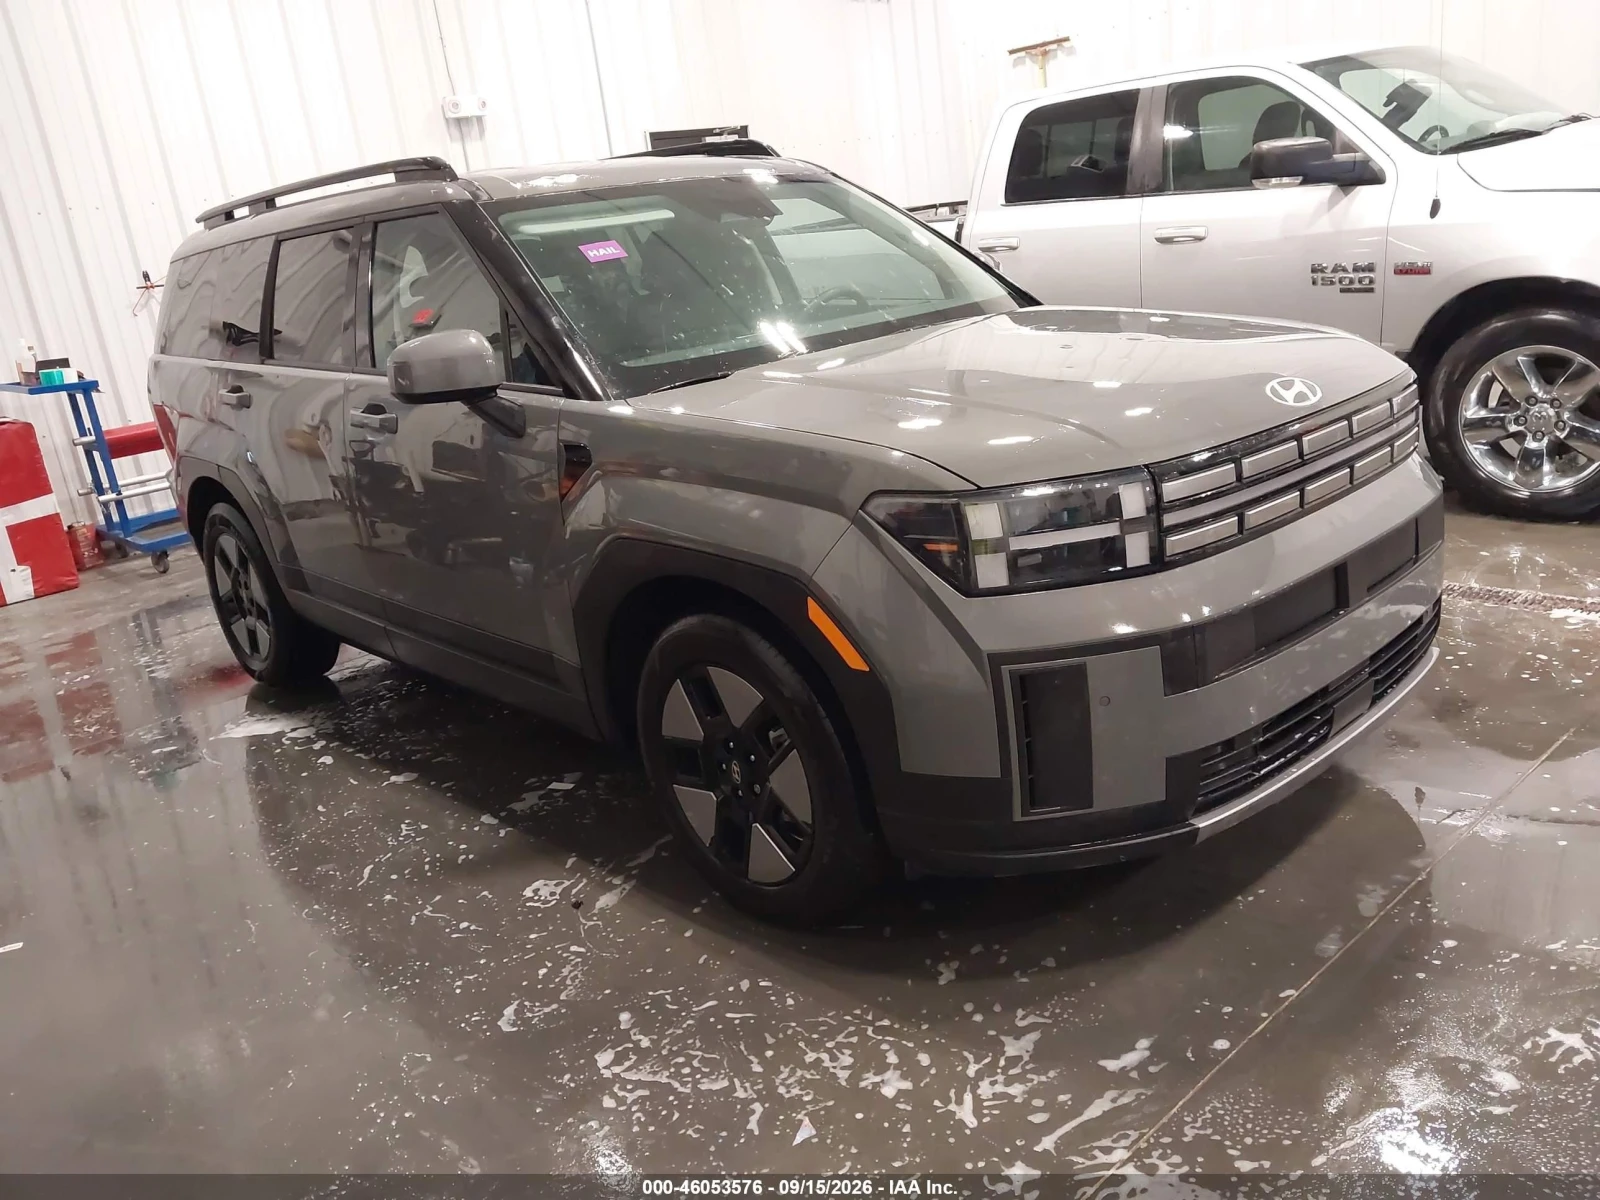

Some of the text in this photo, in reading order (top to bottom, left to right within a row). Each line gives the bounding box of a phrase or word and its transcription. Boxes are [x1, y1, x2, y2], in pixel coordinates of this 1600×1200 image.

[587, 246, 621, 258] HAIL
[1310, 262, 1376, 274] RAM
[1310, 274, 1376, 287] 1500
